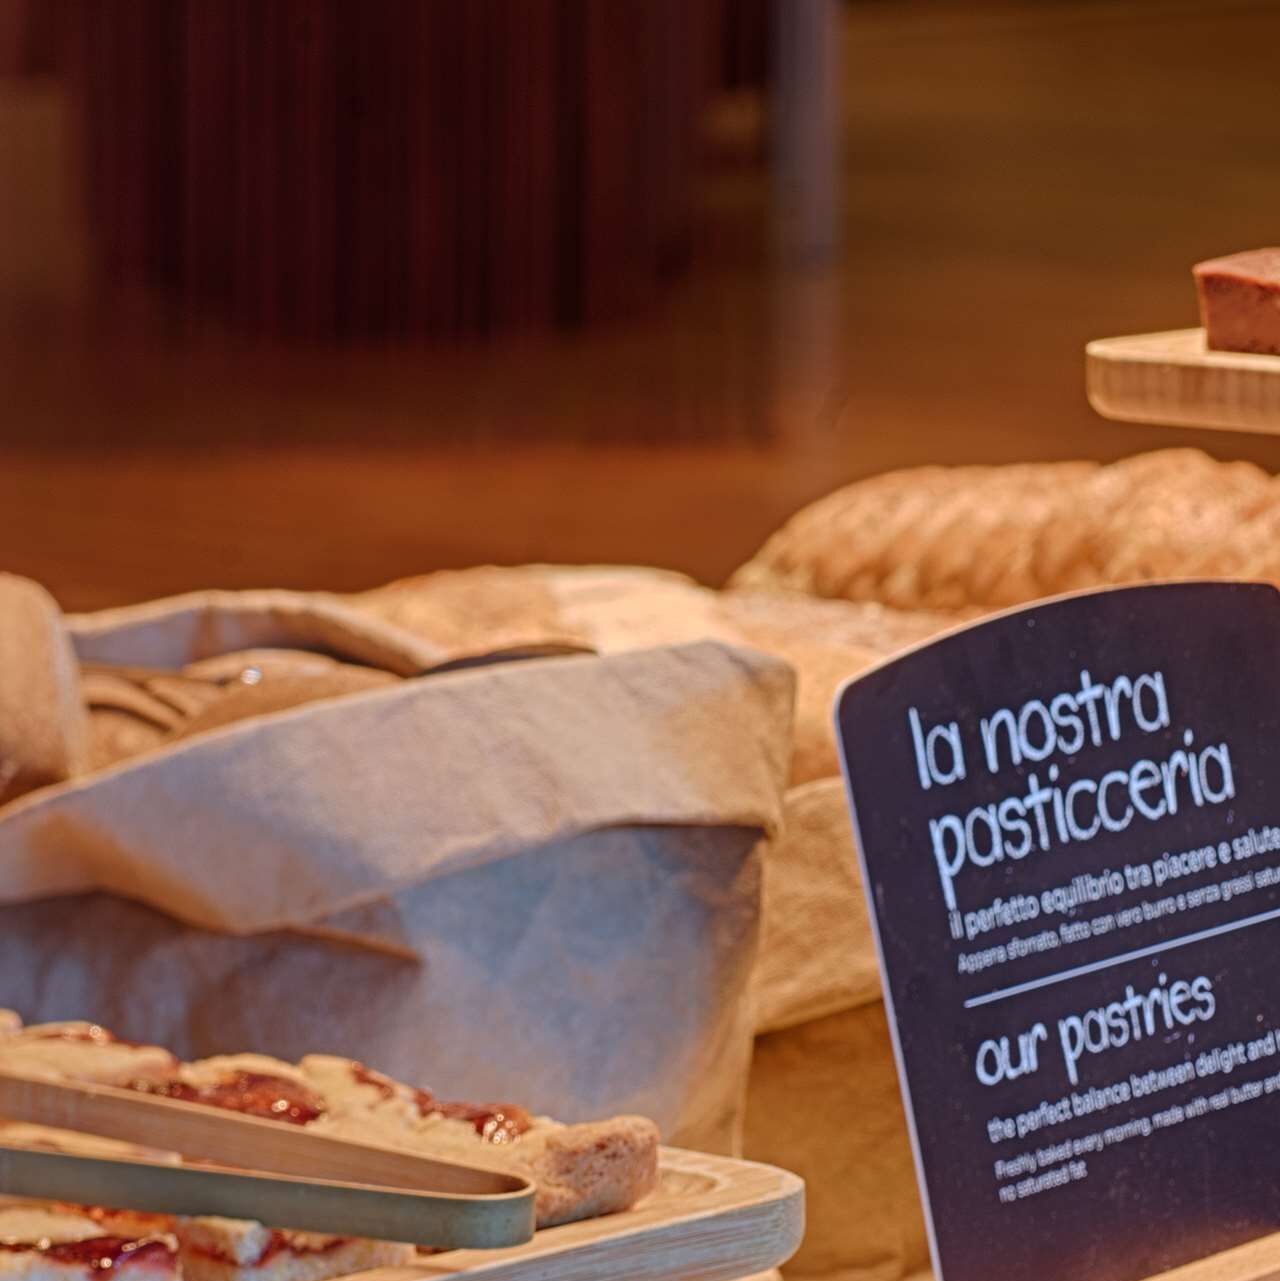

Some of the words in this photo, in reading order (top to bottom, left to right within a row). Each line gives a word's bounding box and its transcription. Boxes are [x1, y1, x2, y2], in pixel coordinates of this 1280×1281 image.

[908, 704, 967, 791] la
[980, 668, 1170, 774] nostra
[927, 730, 1237, 911] pasticceria
[964, 893, 1041, 942] perfetto
[1041, 869, 1124, 915] equilibrio
[1124, 862, 1153, 891] tra
[1151, 843, 1218, 887] piacere
[1217, 841, 1232, 864] e
[1059, 919, 1092, 945] fatto
[1091, 913, 1116, 936] con
[1115, 905, 1143, 929] vero
[1142, 896, 1177, 921] burro
[1176, 894, 1187, 912] e
[1186, 884, 1222, 909] senza
[975, 1015, 1048, 1088] our
[1057, 969, 1216, 1086] pastries
[986, 1115, 1016, 1144] the
[1016, 1098, 1073, 1138] perfect
[1071, 1078, 1132, 1117] balance
[1130, 1059, 1196, 1099] between
[1195, 1041, 1247, 1077] delight
[1246, 1030, 1277, 1061] and
[1036, 1138, 1073, 1168] baked
[1072, 1132, 1104, 1156] every
[1151, 1104, 1185, 1129] made
[1185, 1095, 1209, 1119] with
[998, 1184, 1017, 1205] no
[1016, 1164, 1071, 1199] saturated
